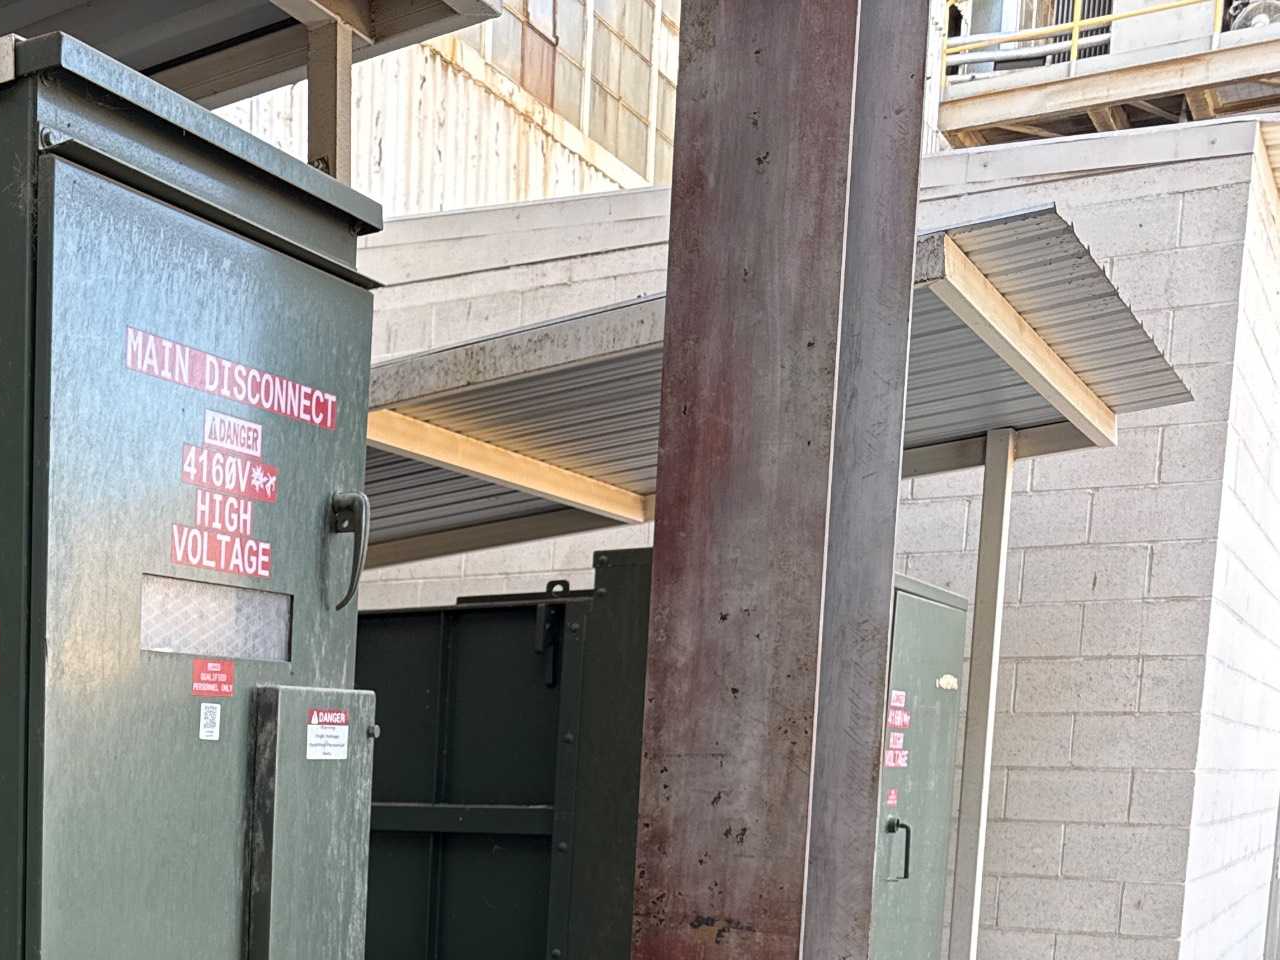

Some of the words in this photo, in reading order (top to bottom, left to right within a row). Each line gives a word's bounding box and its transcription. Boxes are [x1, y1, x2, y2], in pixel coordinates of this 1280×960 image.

[126, 325, 191, 385] MAIN
[204, 356, 336, 427] DISCONNECT
[219, 417, 259, 453] DANGER
[196, 489, 252, 536] HIGH
[172, 524, 270, 577] VOLTAGE
[318, 711, 346, 724] DANGER
